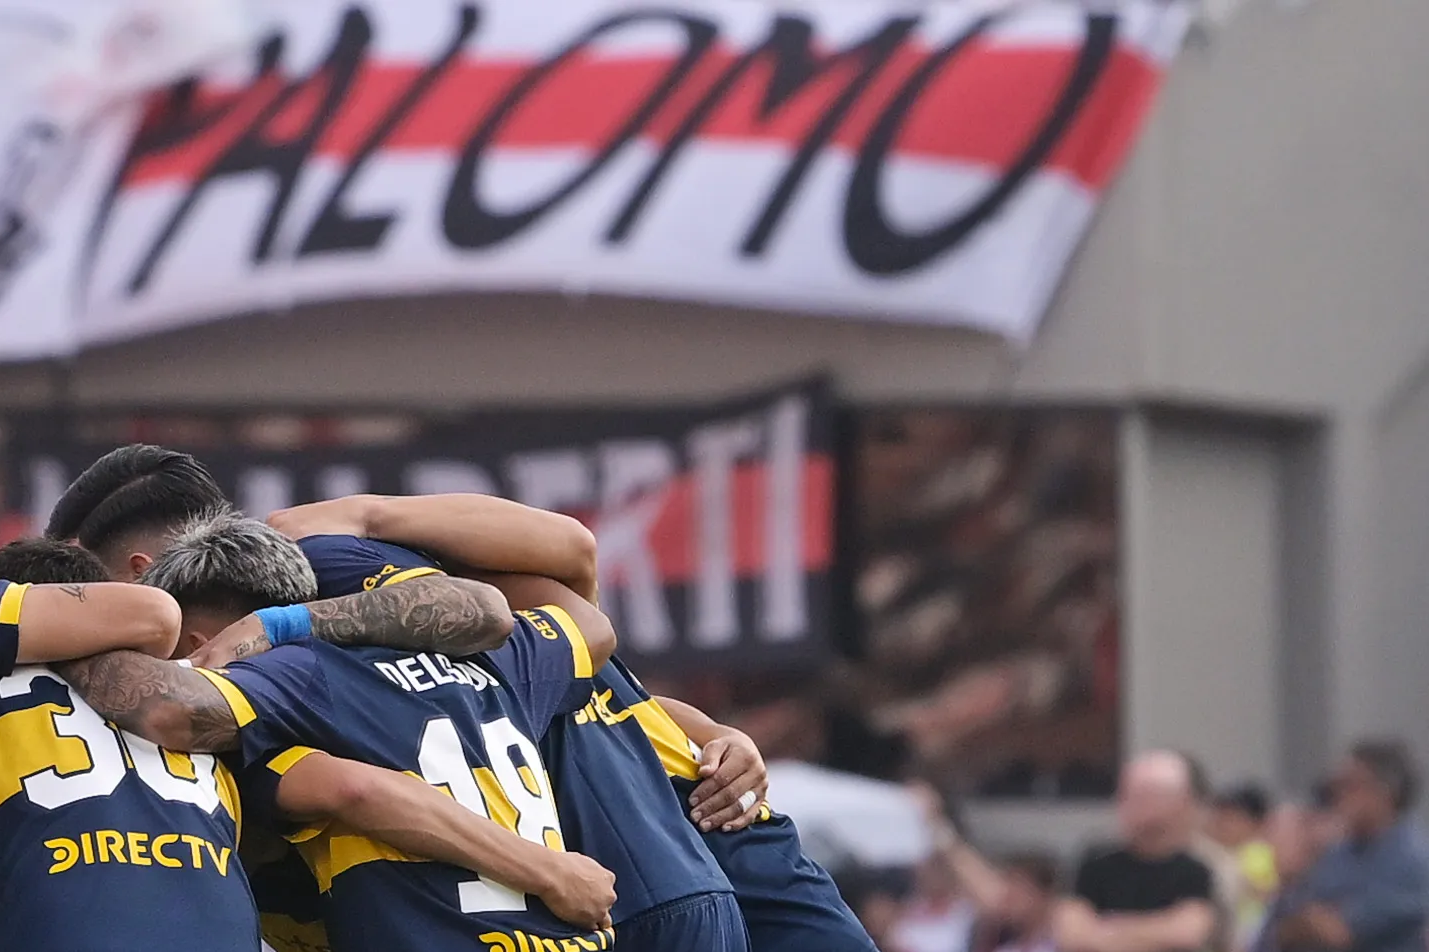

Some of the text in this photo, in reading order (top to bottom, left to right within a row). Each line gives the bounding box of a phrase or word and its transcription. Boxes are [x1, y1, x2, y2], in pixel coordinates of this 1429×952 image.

[78, 2, 1122, 300] PALOMO
[43, 829, 232, 878] DIRECTV
[417, 716, 567, 914] 18
